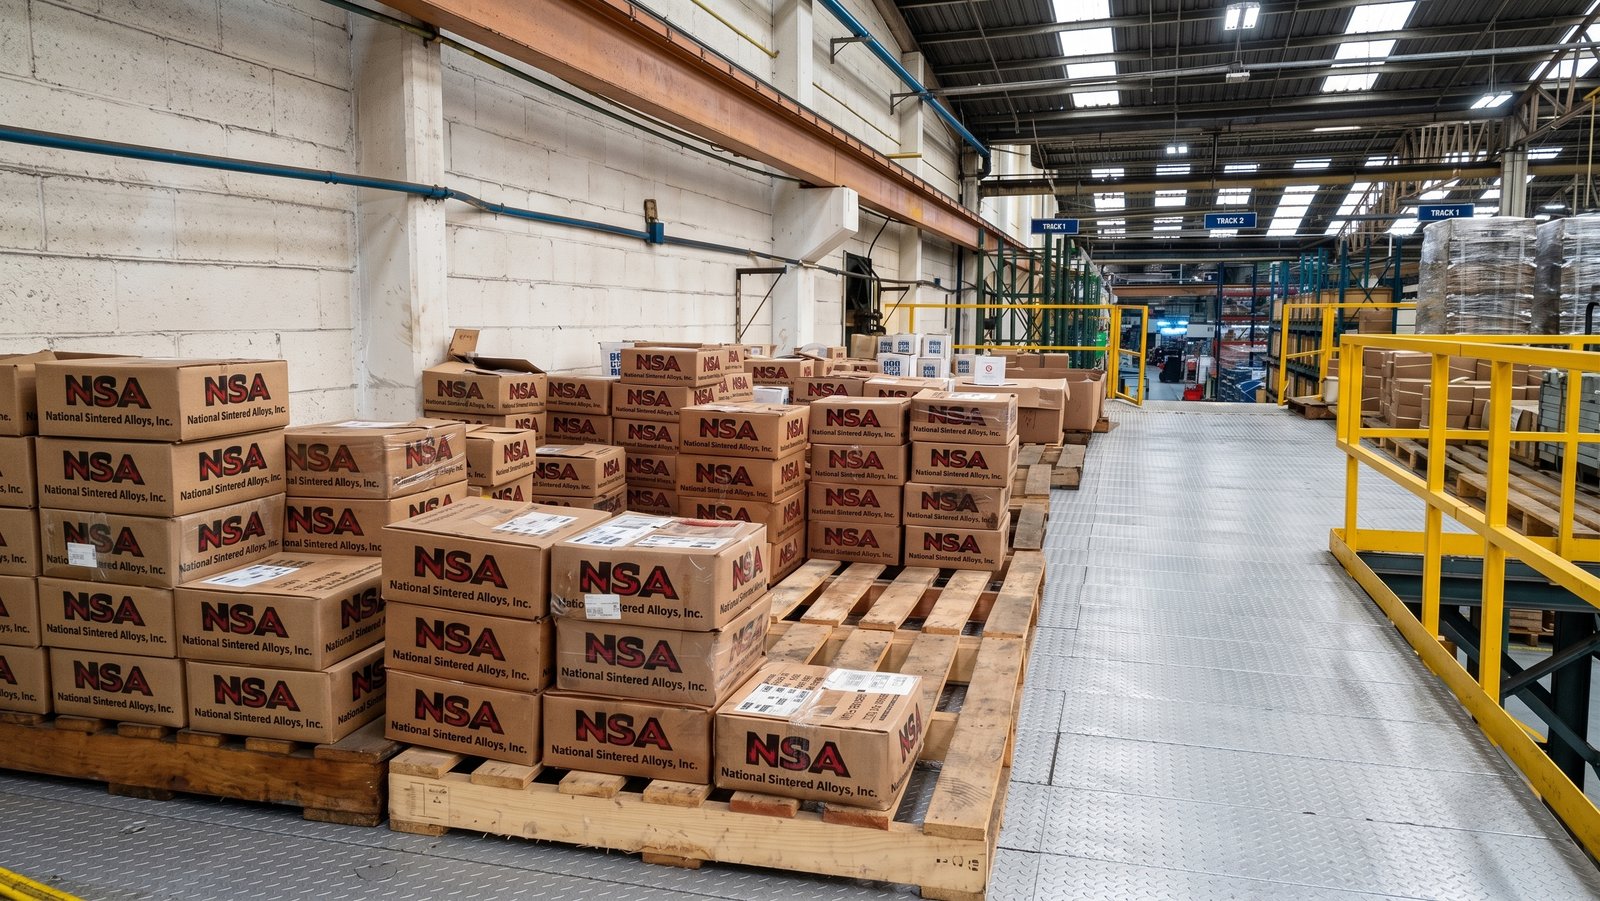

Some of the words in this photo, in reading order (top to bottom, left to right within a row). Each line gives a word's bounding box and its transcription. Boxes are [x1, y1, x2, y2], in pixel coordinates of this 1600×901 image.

[636, 354, 681, 372] NSA
[704, 356, 720, 372] NSA
[753, 366, 788, 379] NSA
[65, 375, 152, 409] NSA
[204, 373, 271, 406] NSA
[438, 380, 483, 400] NSA
[509, 382, 538, 400] NSA
[548, 382, 591, 400] NSA
[627, 389, 672, 407] NSA
[694, 388, 714, 405] NSA
[808, 382, 848, 397] NSA
[46, 411, 83, 422] National
[85, 413, 122, 424] Sintered
[124, 415, 154, 427] Alloys,
[156, 417, 173, 426] Inc.
[188, 412, 220, 424] National
[221, 408, 250, 420] Sintered
[252, 407, 273, 417] Alloys,
[274, 405, 286, 414] Inc.
[826, 409, 881, 428] NSA
[928, 405, 986, 426] NSA
[553, 417, 596, 435] NSA
[628, 424, 672, 442] NSA
[700, 418, 758, 441] NSA
[786, 418, 804, 440] NSA
[285, 443, 360, 472] NSA
[405, 435, 452, 469] NSA
[504, 440, 530, 464] NSA
[738, 443, 760, 452] Alloys,
[63, 450, 145, 485] NSA
[199, 443, 267, 481] NSA
[603, 458, 620, 478] NSA
[627, 457, 670, 476] NSA
[829, 450, 884, 470] NSA
[931, 449, 988, 470] NSA
[299, 477, 333, 486] Sintered
[335, 478, 362, 488] Alloys,
[364, 479, 379, 488] Inc.
[533, 462, 579, 481] NSA
[696, 463, 753, 487] NSA
[781, 460, 799, 484] NSA
[44, 484, 80, 496] National
[82, 487, 117, 498] Sintered
[120, 490, 148, 502] Alloys,
[150, 492, 166, 502] Inc.
[181, 487, 214, 500] National
[215, 479, 246, 494] Sintered
[247, 475, 269, 487] Alloys,
[270, 473, 281, 482] Inc.
[627, 490, 670, 507] NSA
[826, 488, 880, 508] NSA
[921, 492, 979, 513] NSA
[287, 505, 364, 536] NSA
[697, 504, 752, 521] NSA
[784, 498, 800, 525] NSA
[63, 521, 144, 557] NSA
[198, 511, 266, 553] NSA
[825, 527, 880, 548] NSA
[924, 532, 981, 554] NSA
[180, 556, 213, 573] National
[214, 547, 244, 564] Sintered
[245, 542, 267, 555] Alloys,
[268, 540, 279, 549] Inc.
[304, 540, 338, 549] Sintered
[340, 542, 368, 552] Alloys,
[779, 538, 797, 567] NSA
[120, 561, 148, 574] Alloys,
[150, 565, 166, 575] Inc.
[414, 545, 508, 589] NSA
[733, 546, 763, 592] NSA
[579, 560, 679, 600] NSA
[390, 580, 430, 594] National
[433, 585, 474, 601] Sintered
[477, 592, 510, 607] Alloys,
[513, 597, 531, 608] Inc.
[63, 591, 145, 627] NSA
[201, 602, 289, 638] NSA
[647, 604, 681, 618] Alloys,
[684, 608, 703, 618] Inc.
[47, 624, 82, 636] National
[83, 627, 118, 638] Sintered
[120, 631, 148, 644] Alloys,
[150, 634, 167, 643] Inc.
[326, 632, 354, 652] National
[356, 619, 380, 638] Sintered
[416, 616, 506, 661] NSA
[182, 635, 219, 647] National
[222, 638, 260, 650] Sintered
[262, 642, 293, 656] Alloys,
[294, 644, 312, 656] Inc.
[585, 632, 682, 673] NSA
[392, 649, 431, 665] National
[434, 656, 474, 672] Sintered
[476, 663, 509, 679] Alloys,
[512, 670, 530, 681] Inc.
[74, 660, 153, 696] NSA
[561, 667, 603, 681] National
[606, 672, 649, 685] Sintered
[651, 677, 686, 692] Alloys,
[688, 680, 707, 692] Inc.
[58, 692, 91, 704] National
[93, 696, 127, 708] Sintered
[129, 701, 156, 713] Alloys,
[158, 704, 174, 714] Inc.
[213, 674, 300, 712] NSA
[195, 708, 231, 720] National
[234, 712, 271, 724] Sintered
[274, 716, 304, 728] Alloys,
[306, 719, 323, 729] Inc.
[415, 688, 504, 735] NSA
[392, 720, 430, 736] National
[433, 729, 472, 744] Sintered
[474, 736, 506, 752] Alloys,
[509, 742, 527, 754] Inc.
[575, 710, 673, 752] NSA
[899, 703, 922, 764] NSA
[551, 744, 593, 758] National
[596, 750, 638, 764] Sintered
[641, 755, 676, 770] Alloys,
[679, 759, 698, 770] Inc.
[746, 731, 851, 778] NSA
[721, 767, 765, 783] National
[768, 774, 814, 790] Sintered
[816, 780, 853, 797] Alloys,
[857, 785, 877, 798] Inc.
